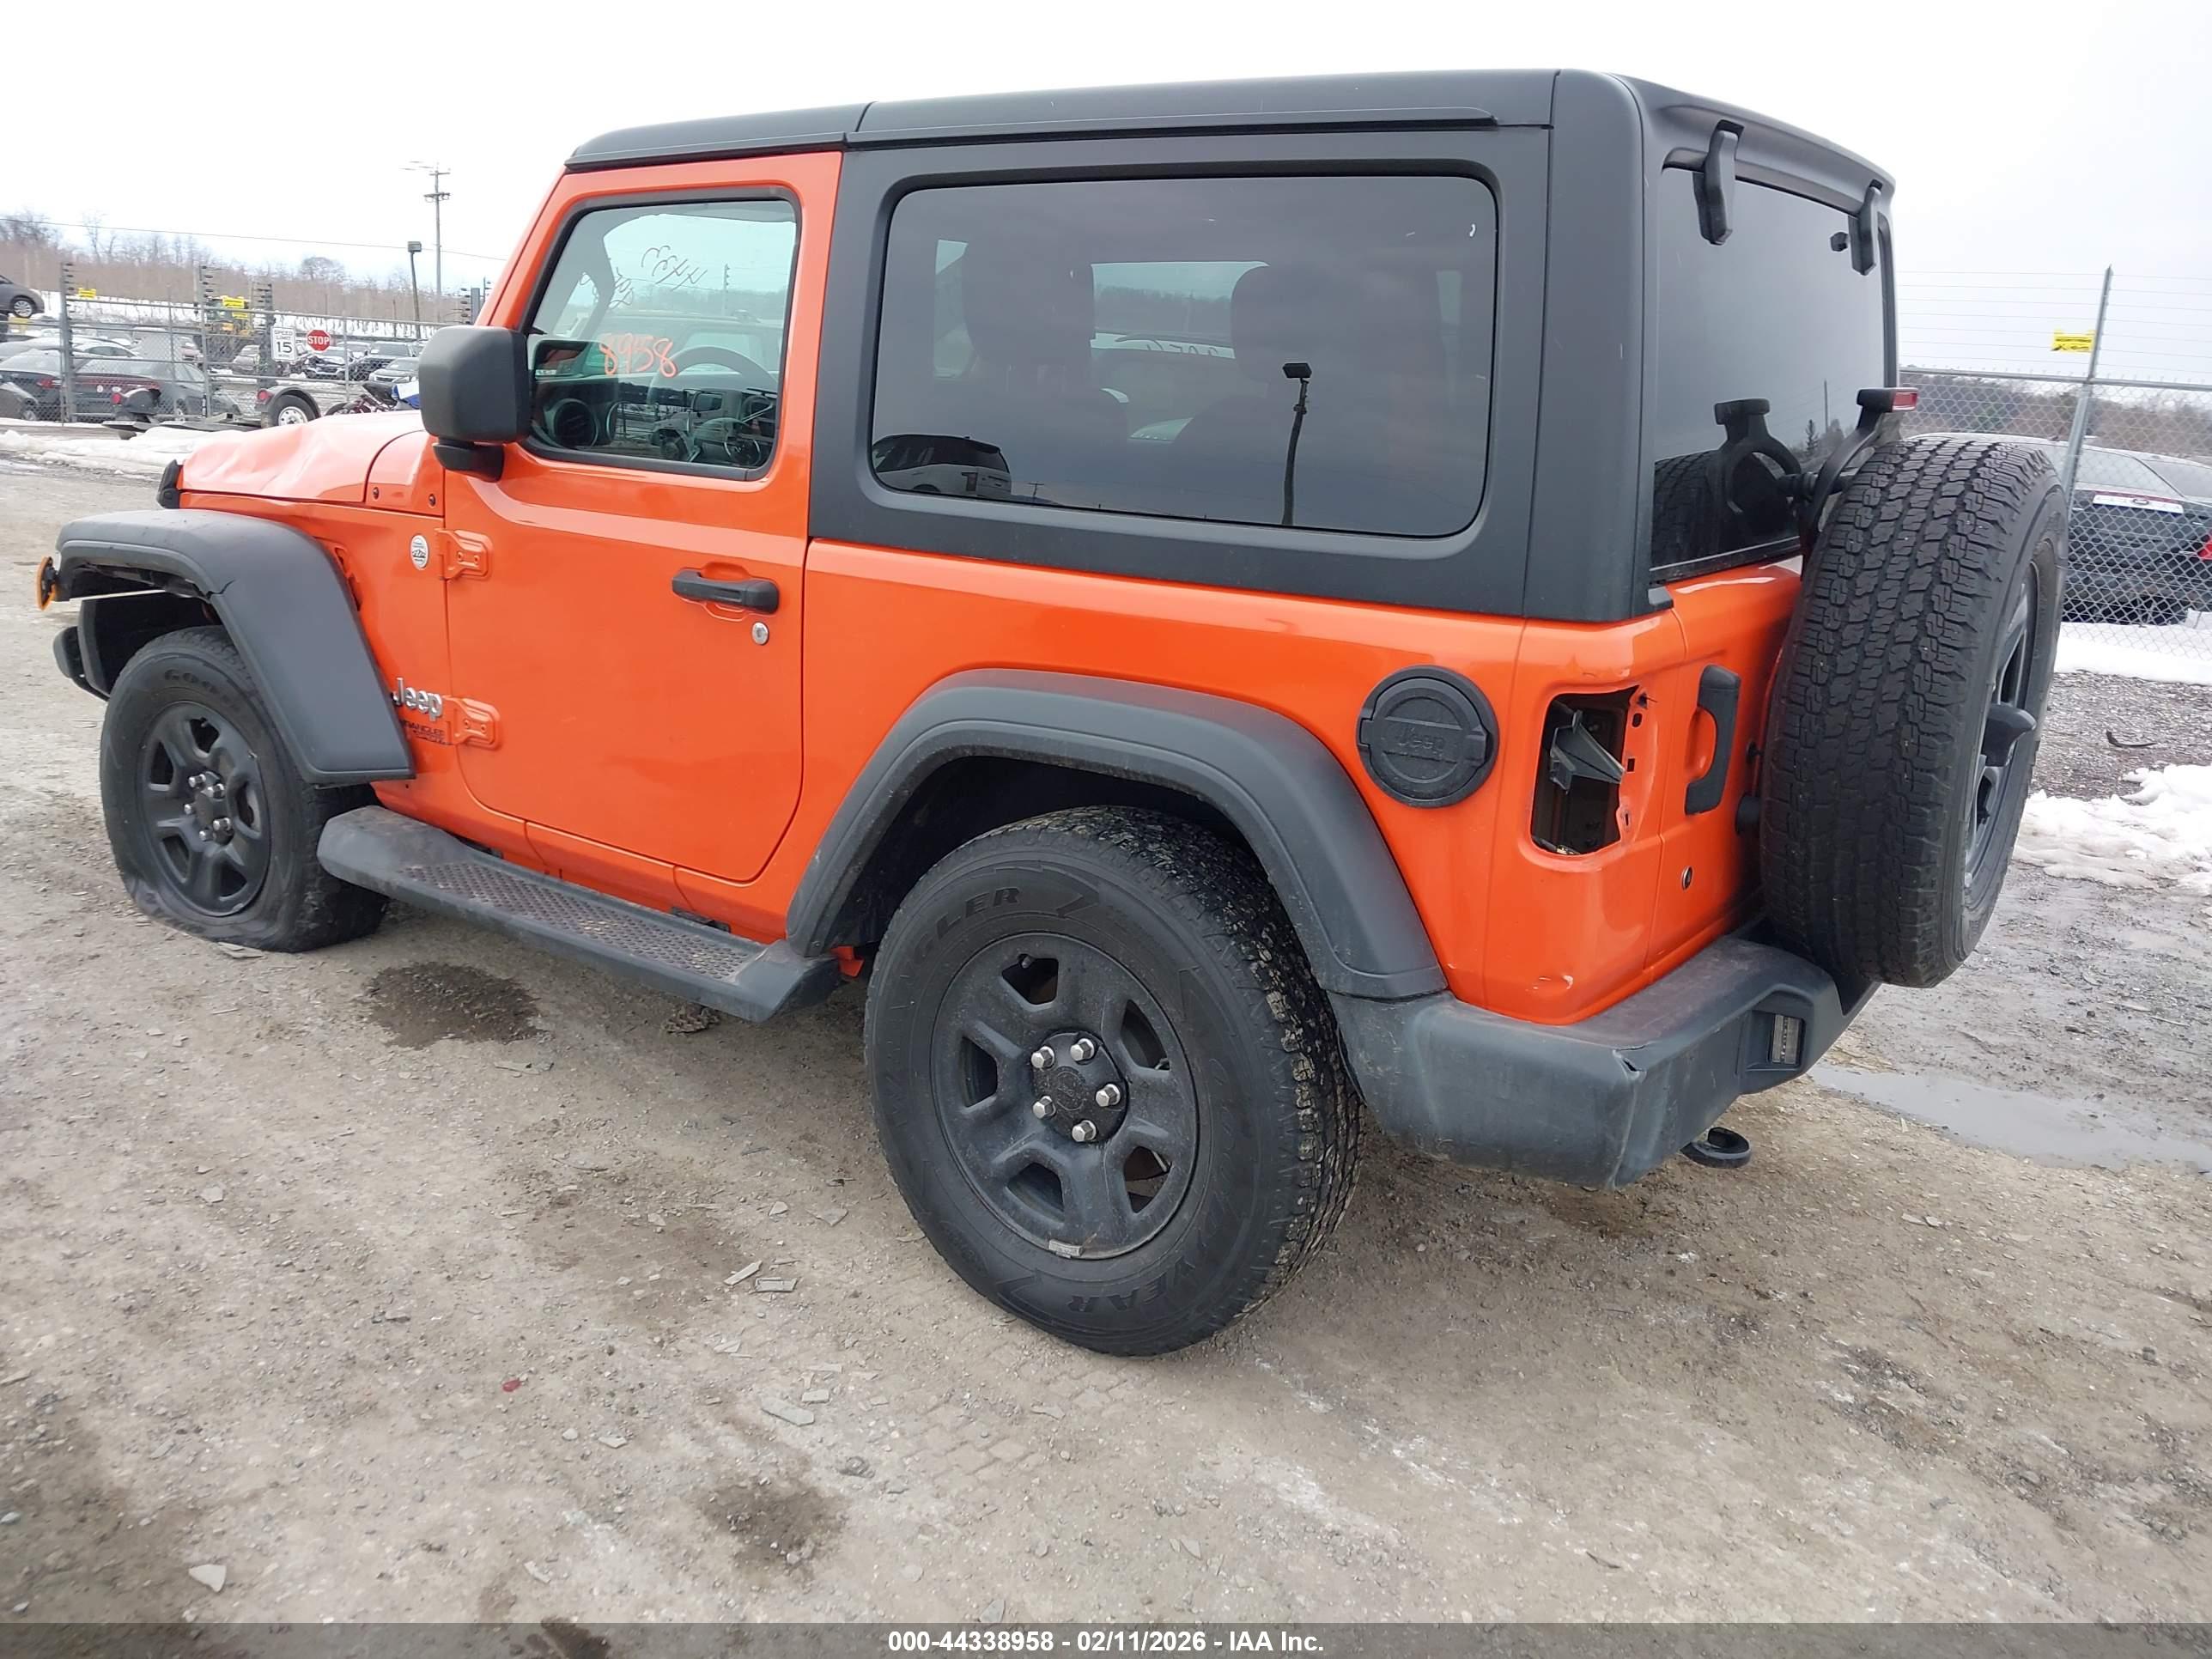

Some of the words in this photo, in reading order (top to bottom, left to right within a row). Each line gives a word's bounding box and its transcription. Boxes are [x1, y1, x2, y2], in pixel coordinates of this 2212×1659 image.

[276, 341, 293, 354] 15
[307, 336, 331, 345] STOP
[599, 332, 677, 378] 8958
[392, 677, 443, 721] Jeep
[1397, 726, 1445, 757] Jeep
